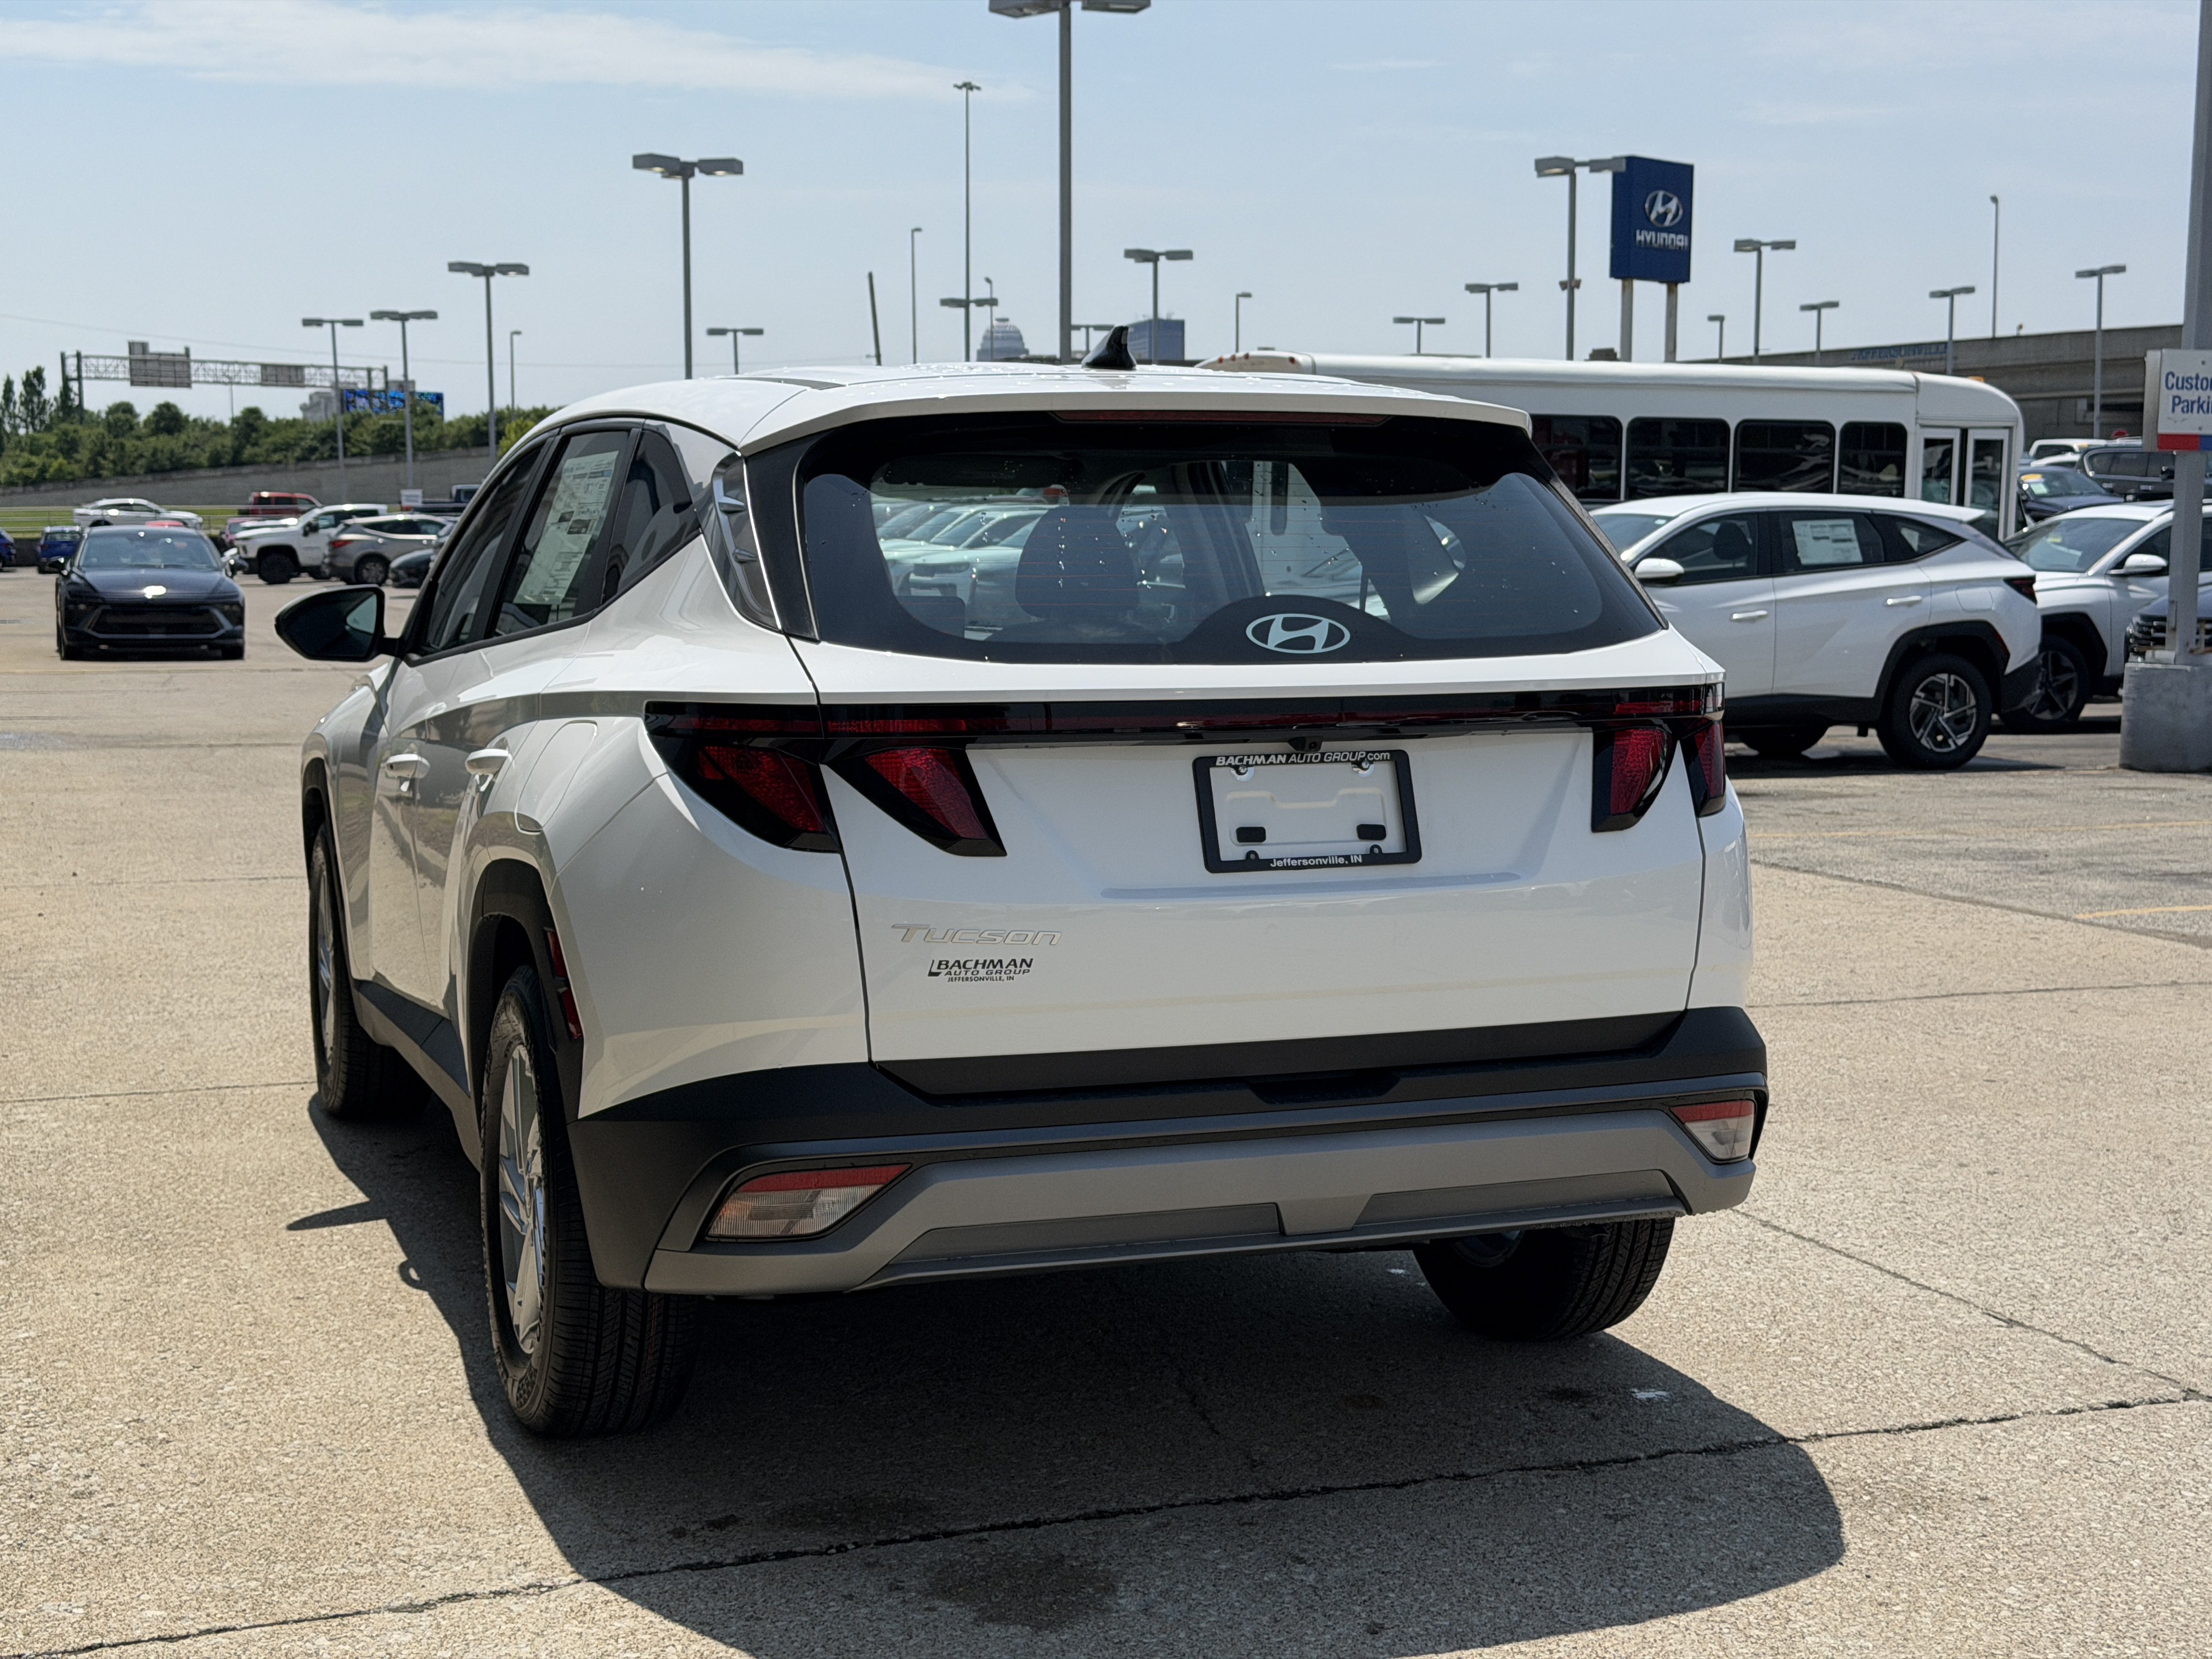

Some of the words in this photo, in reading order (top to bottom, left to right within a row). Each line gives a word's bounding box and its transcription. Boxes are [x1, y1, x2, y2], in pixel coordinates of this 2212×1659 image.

[1636, 229, 1689, 250] HYUNDAI
[2165, 371, 2212, 391] Custo
[2171, 394, 2212, 414] Parki
[1216, 754, 1286, 766] BACHMAN
[1288, 753, 1321, 763] AUTO
[1323, 751, 1390, 762] GROUP.com
[1270, 855, 1348, 867] Jeffersonville,
[1351, 854, 1362, 864] IN
[936, 958, 1034, 970] BACHMAN
